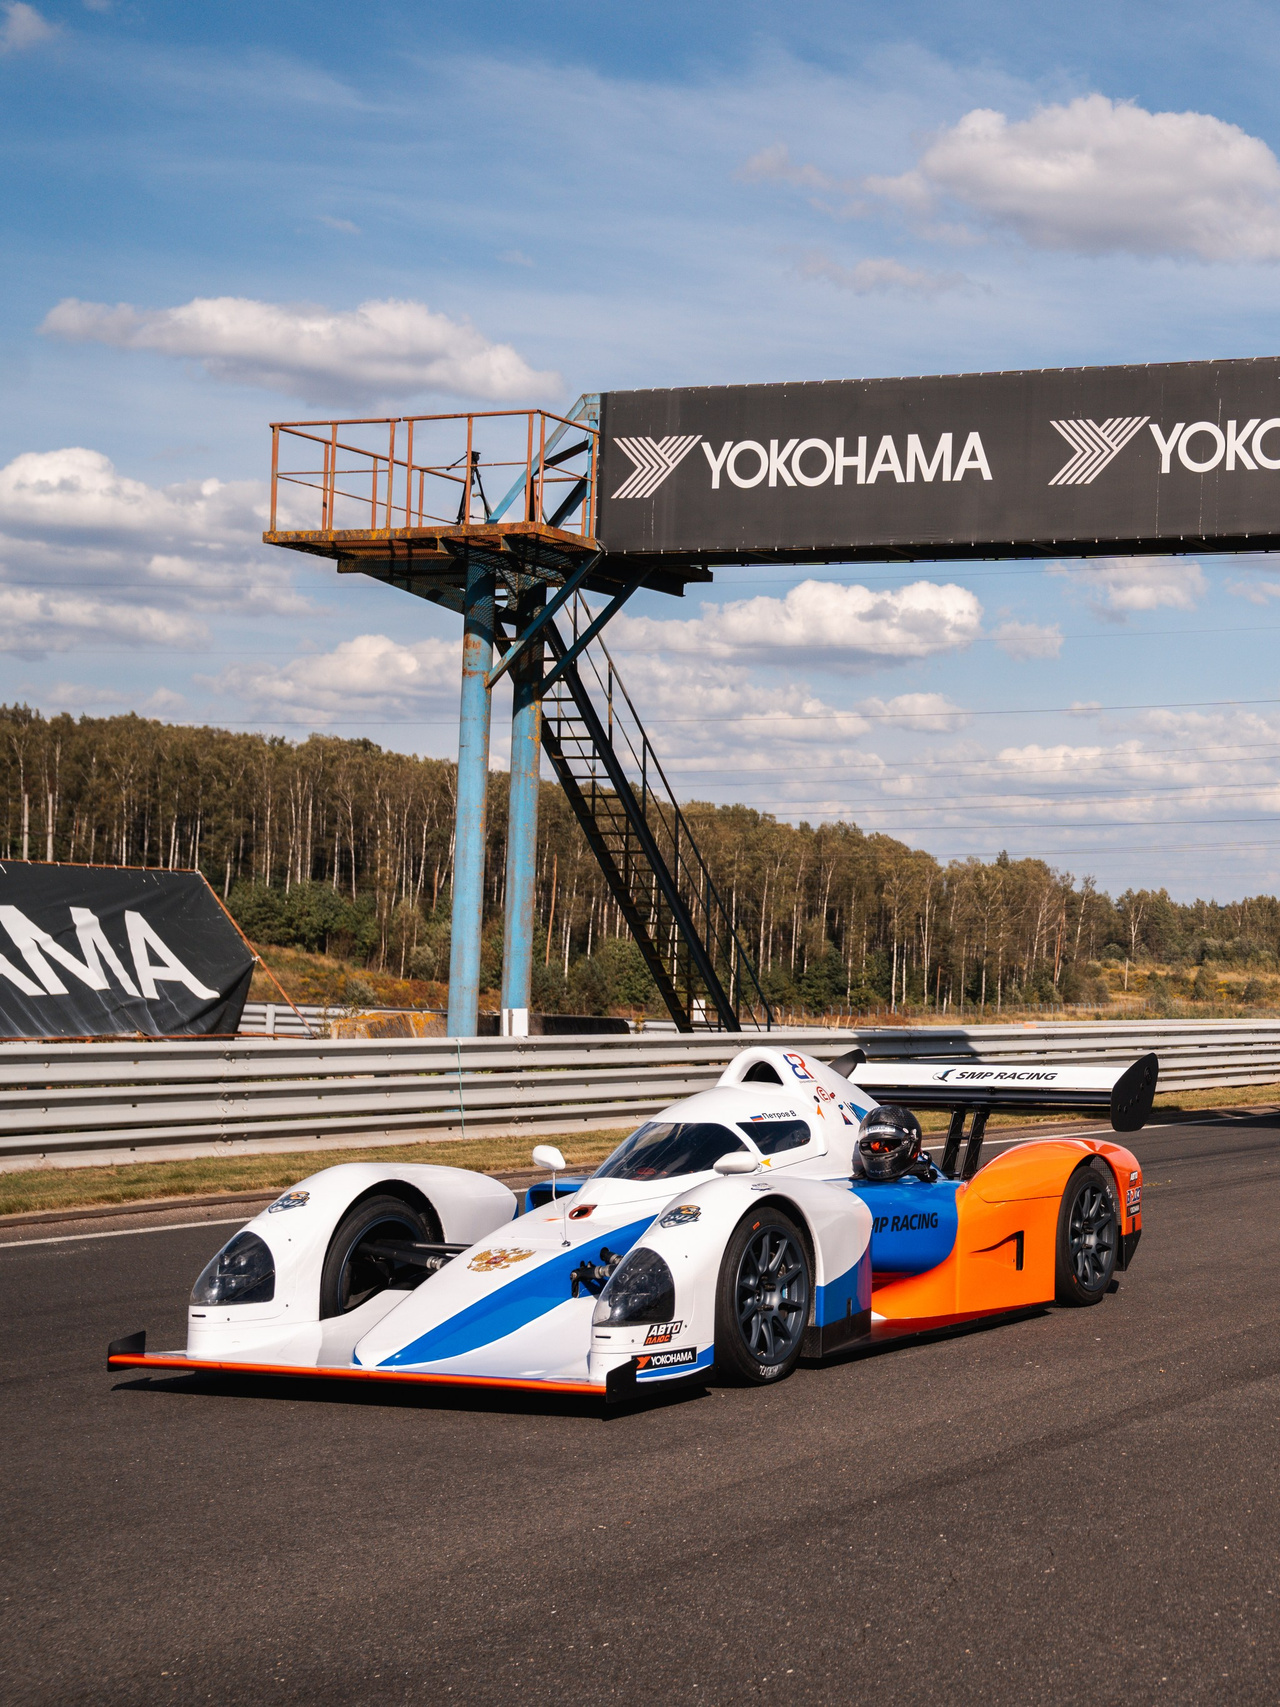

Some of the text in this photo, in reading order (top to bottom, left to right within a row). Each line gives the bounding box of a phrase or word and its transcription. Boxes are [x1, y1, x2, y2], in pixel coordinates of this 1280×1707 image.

[700, 431, 993, 490] YOKOHAMA
[0, 904, 221, 1001] MA
[955, 1071, 1058, 1081] SMP RACING
[761, 1112, 791, 1120] Петров
[890, 1212, 939, 1232] RACING
[648, 1322, 681, 1337] АВТО
[645, 1334, 671, 1345] ПЛЮС
[651, 1351, 693, 1366] YOKOHAMA
